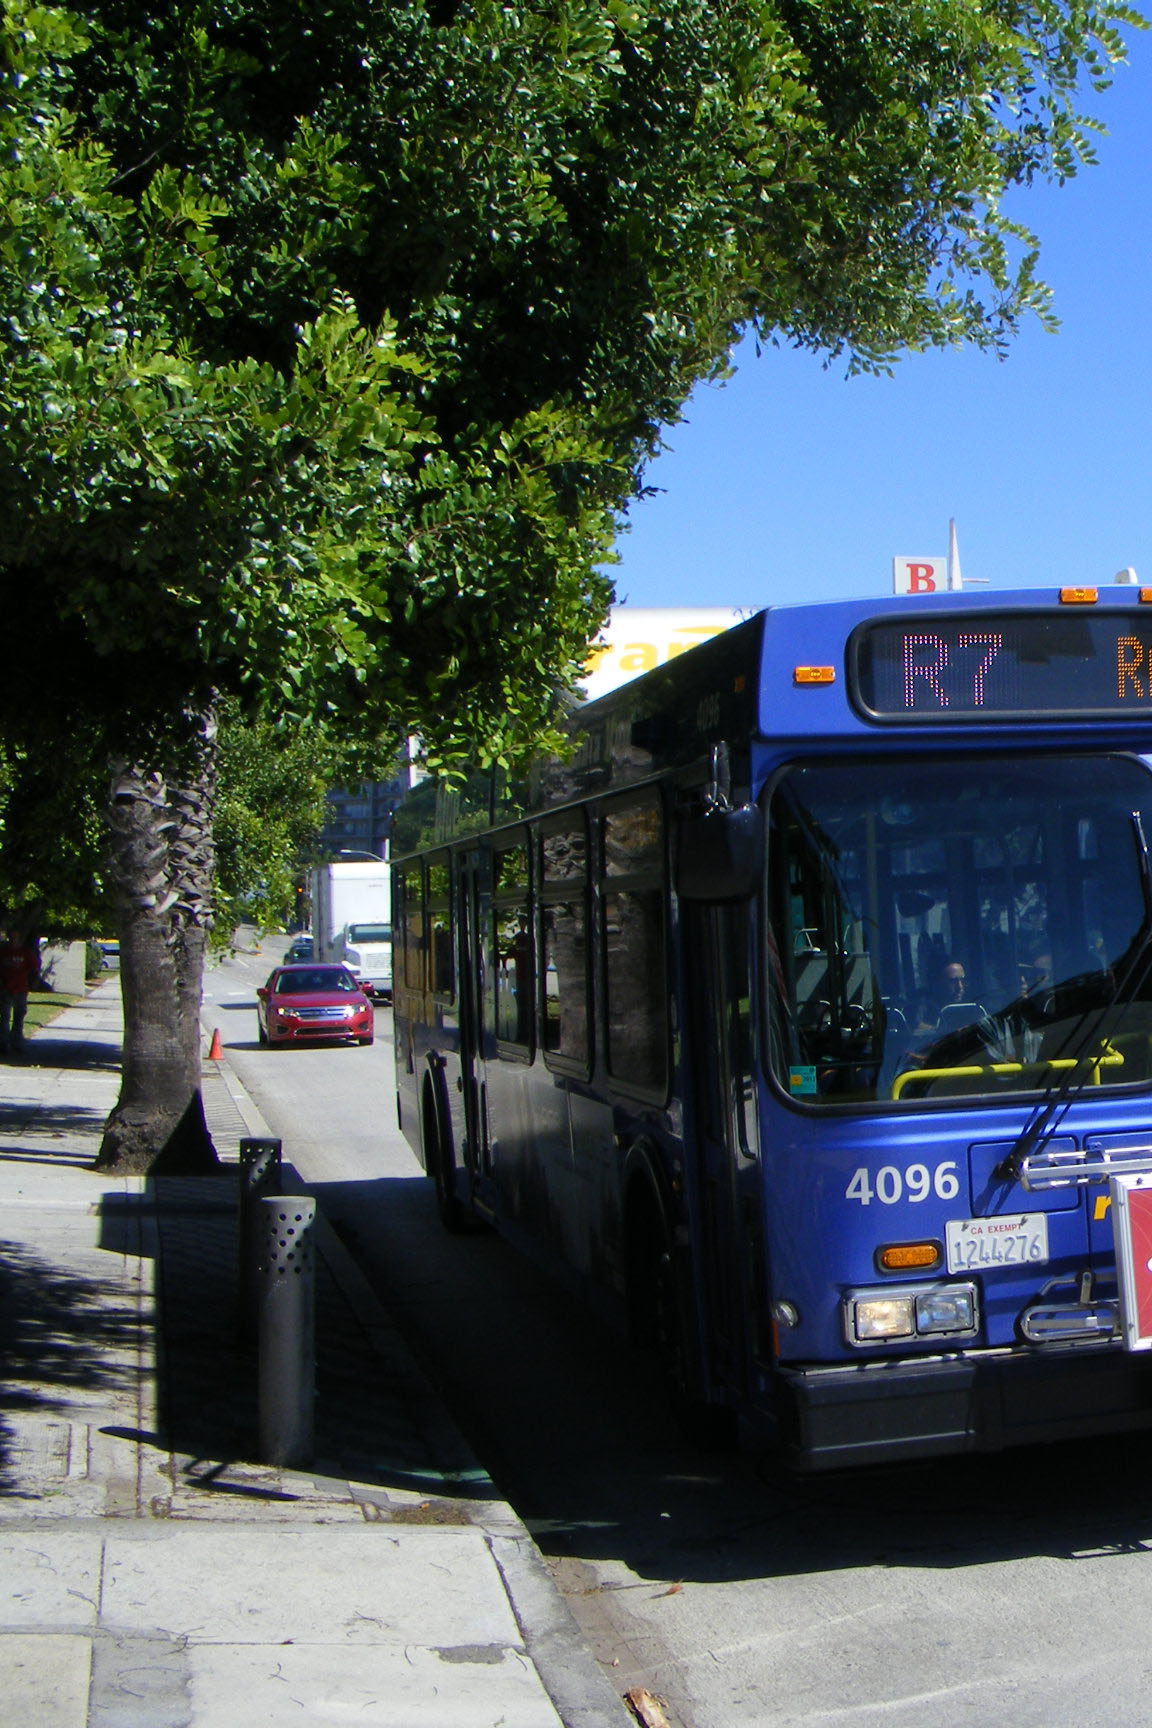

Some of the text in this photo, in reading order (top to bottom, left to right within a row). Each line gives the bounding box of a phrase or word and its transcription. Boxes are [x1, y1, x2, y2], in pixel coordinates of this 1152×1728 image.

[906, 564, 936, 594] B
[903, 633, 1003, 707] R7
[845, 1161, 960, 1206] 4096
[971, 1223, 1023, 1235] CA EXEMPT
[954, 1234, 1042, 1268] 1244276
